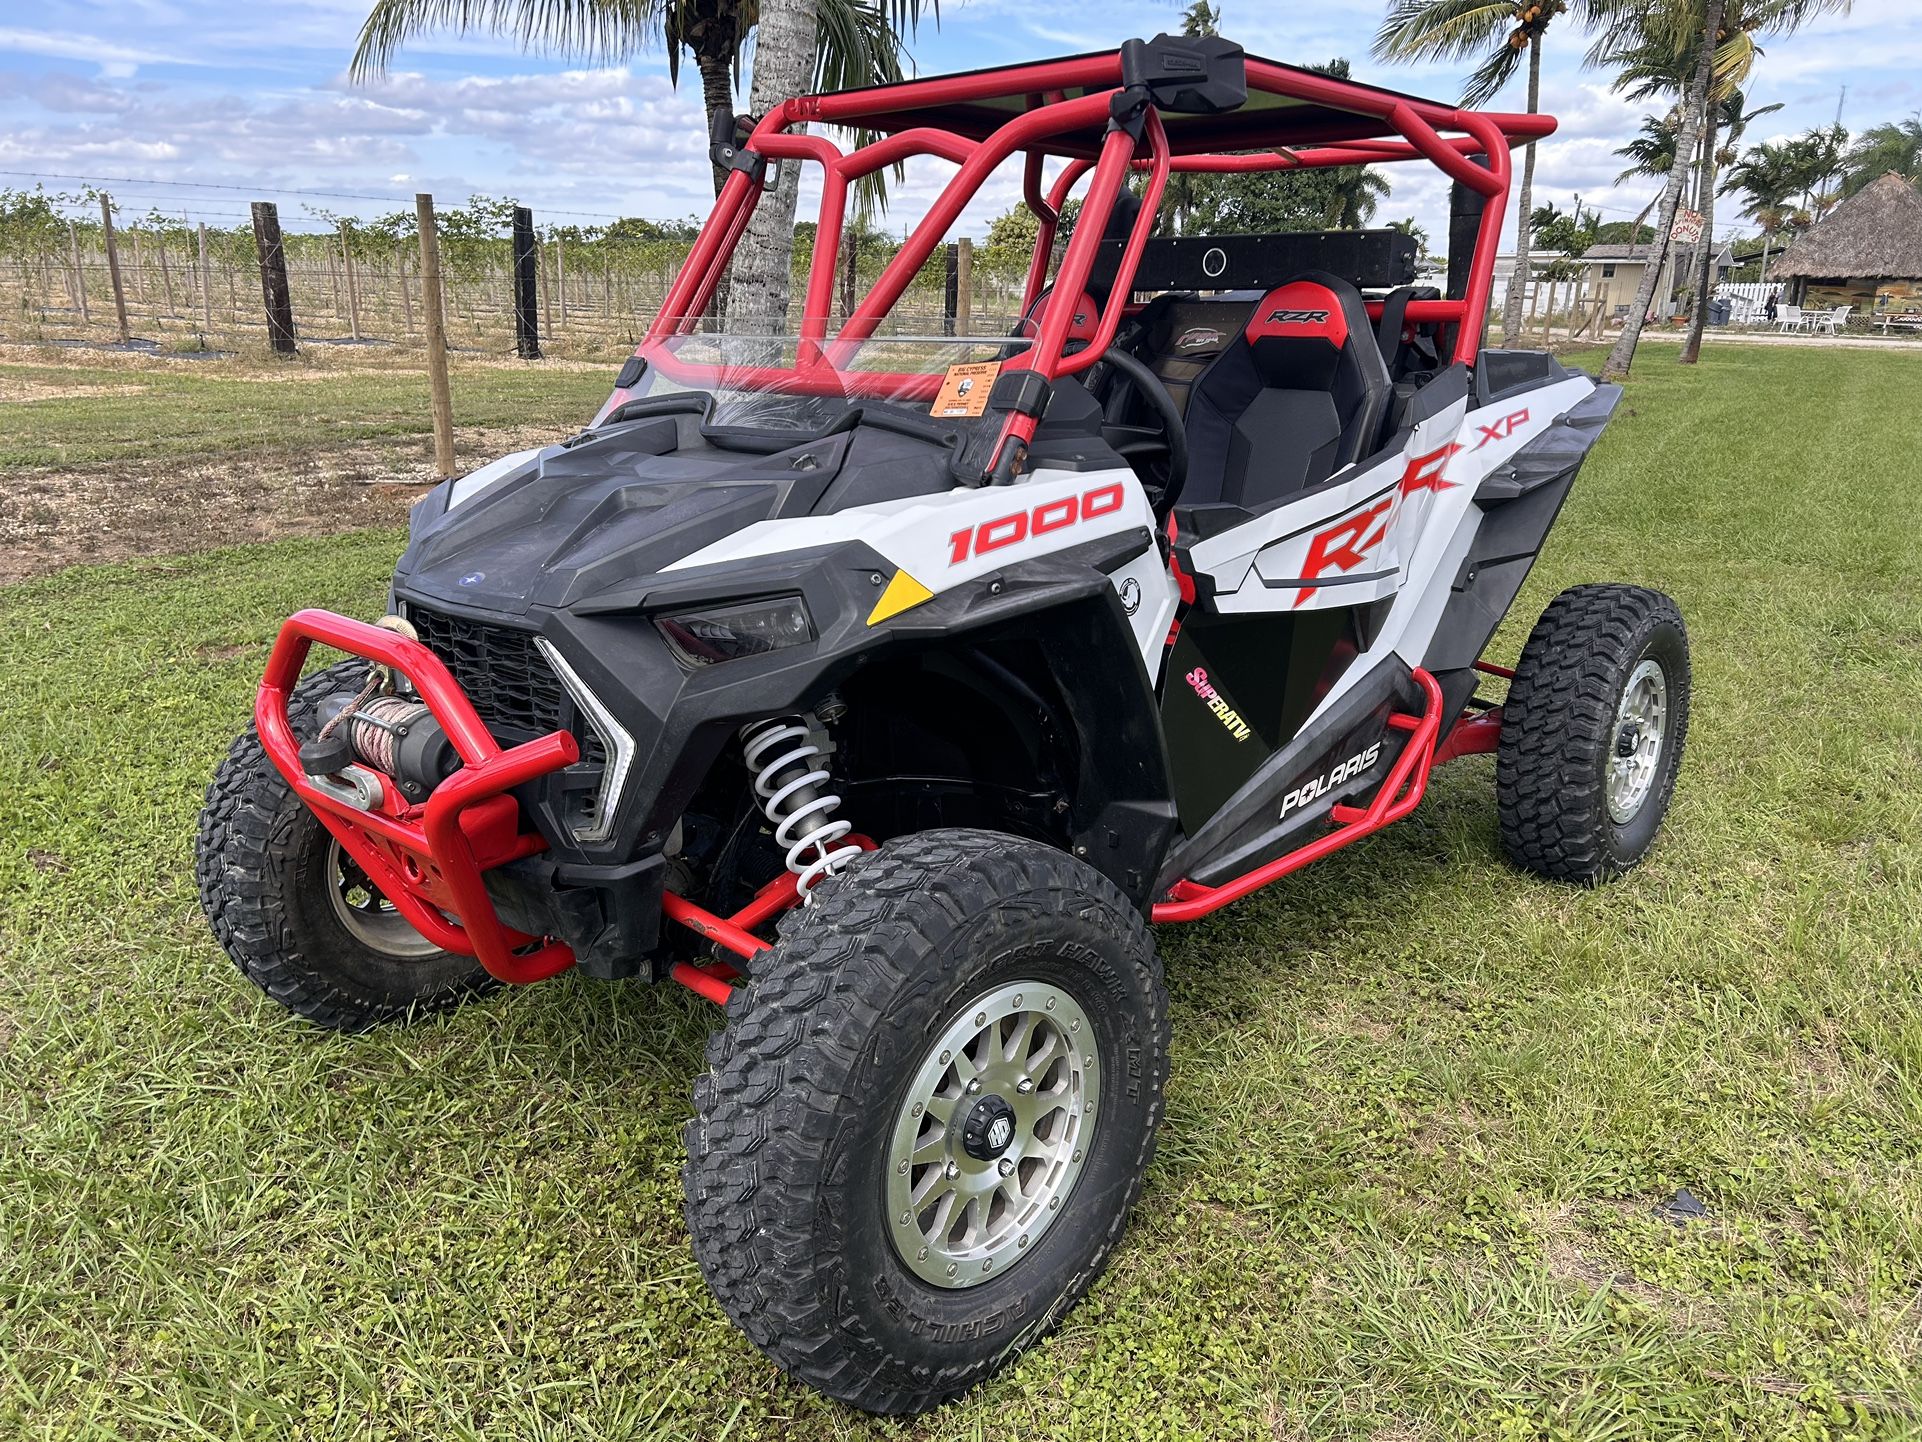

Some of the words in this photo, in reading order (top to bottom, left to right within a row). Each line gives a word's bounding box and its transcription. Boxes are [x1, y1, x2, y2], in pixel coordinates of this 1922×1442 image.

[1671, 225, 1699, 242] DONUTS
[1684, 210, 1697, 218] NO
[1265, 309, 1331, 324] RZR
[1468, 407, 1530, 453] XP
[948, 481, 1124, 568] 1000
[1279, 741, 1382, 819] POLARIS
[1056, 940, 1128, 1002] HAWK
